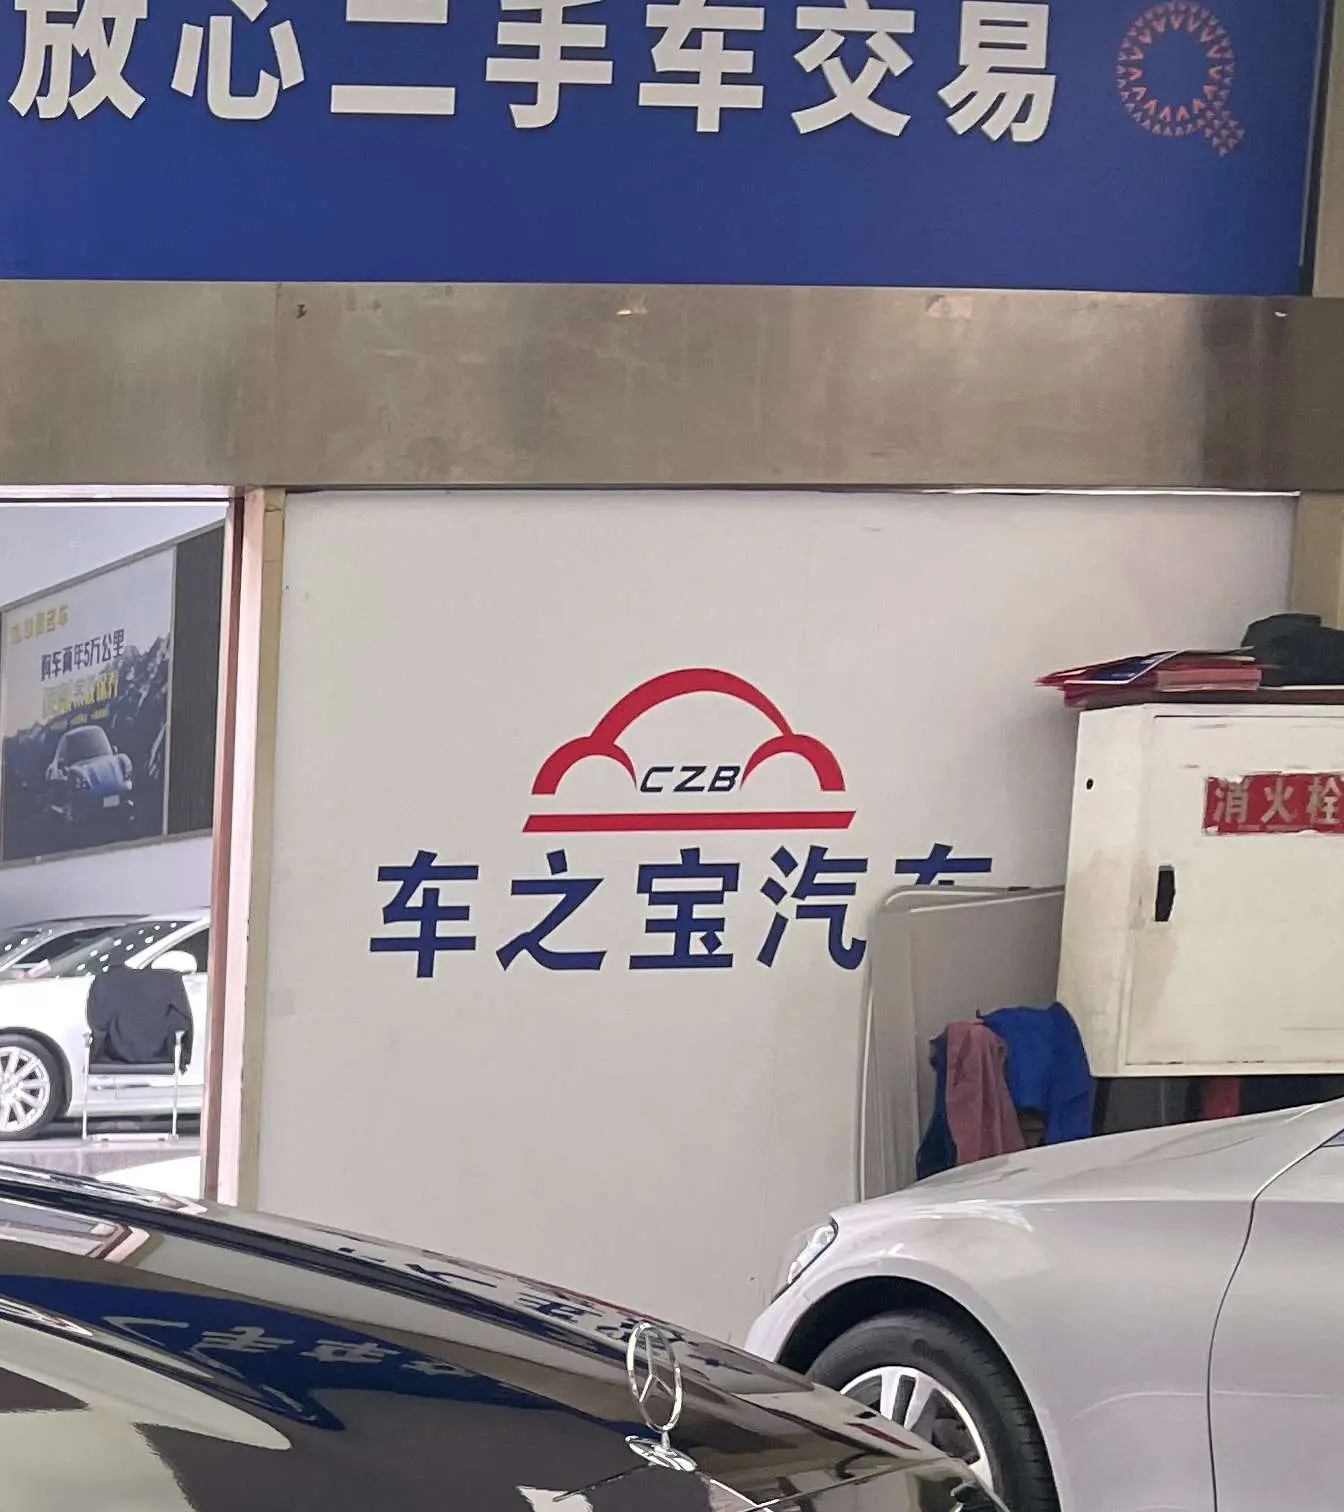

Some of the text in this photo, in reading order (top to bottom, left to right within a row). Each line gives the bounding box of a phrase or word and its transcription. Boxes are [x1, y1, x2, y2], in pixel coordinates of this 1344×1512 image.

[639, 765, 742, 793] CZB
[1212, 775, 1344, 825] 消火栓
